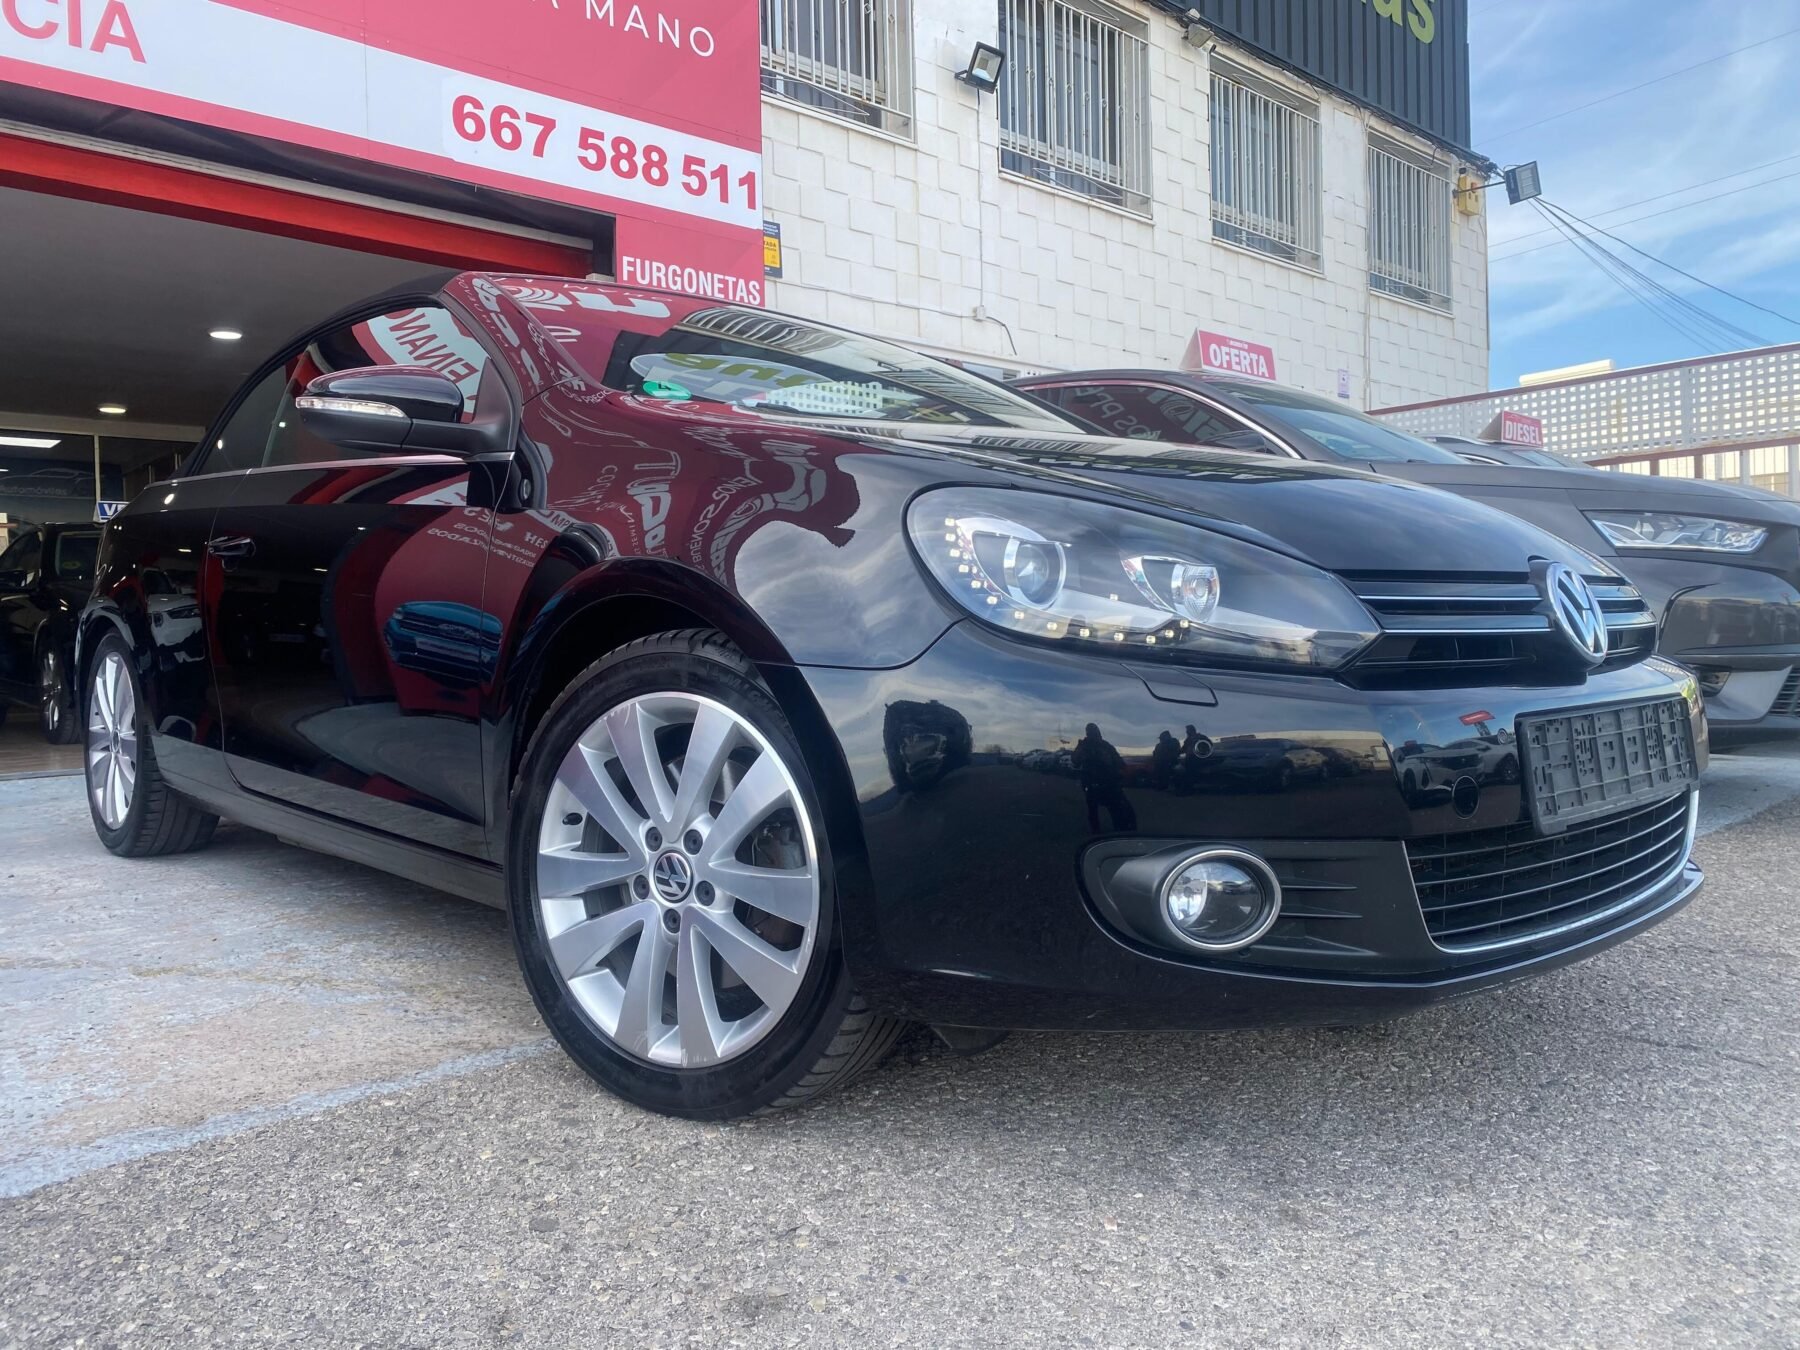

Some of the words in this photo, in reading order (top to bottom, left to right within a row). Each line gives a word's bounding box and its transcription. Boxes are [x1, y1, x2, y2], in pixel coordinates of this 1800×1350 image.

[1, 0, 147, 64] CIA
[585, 0, 715, 57] MANO
[1361, 0, 1435, 44] as
[451, 94, 557, 158] 667
[577, 126, 669, 187] 588
[681, 153, 757, 211] 511
[622, 255, 761, 306] FURGONETAS
[1209, 343, 1270, 378] OFERTA
[1505, 420, 1542, 445] DIESEL
